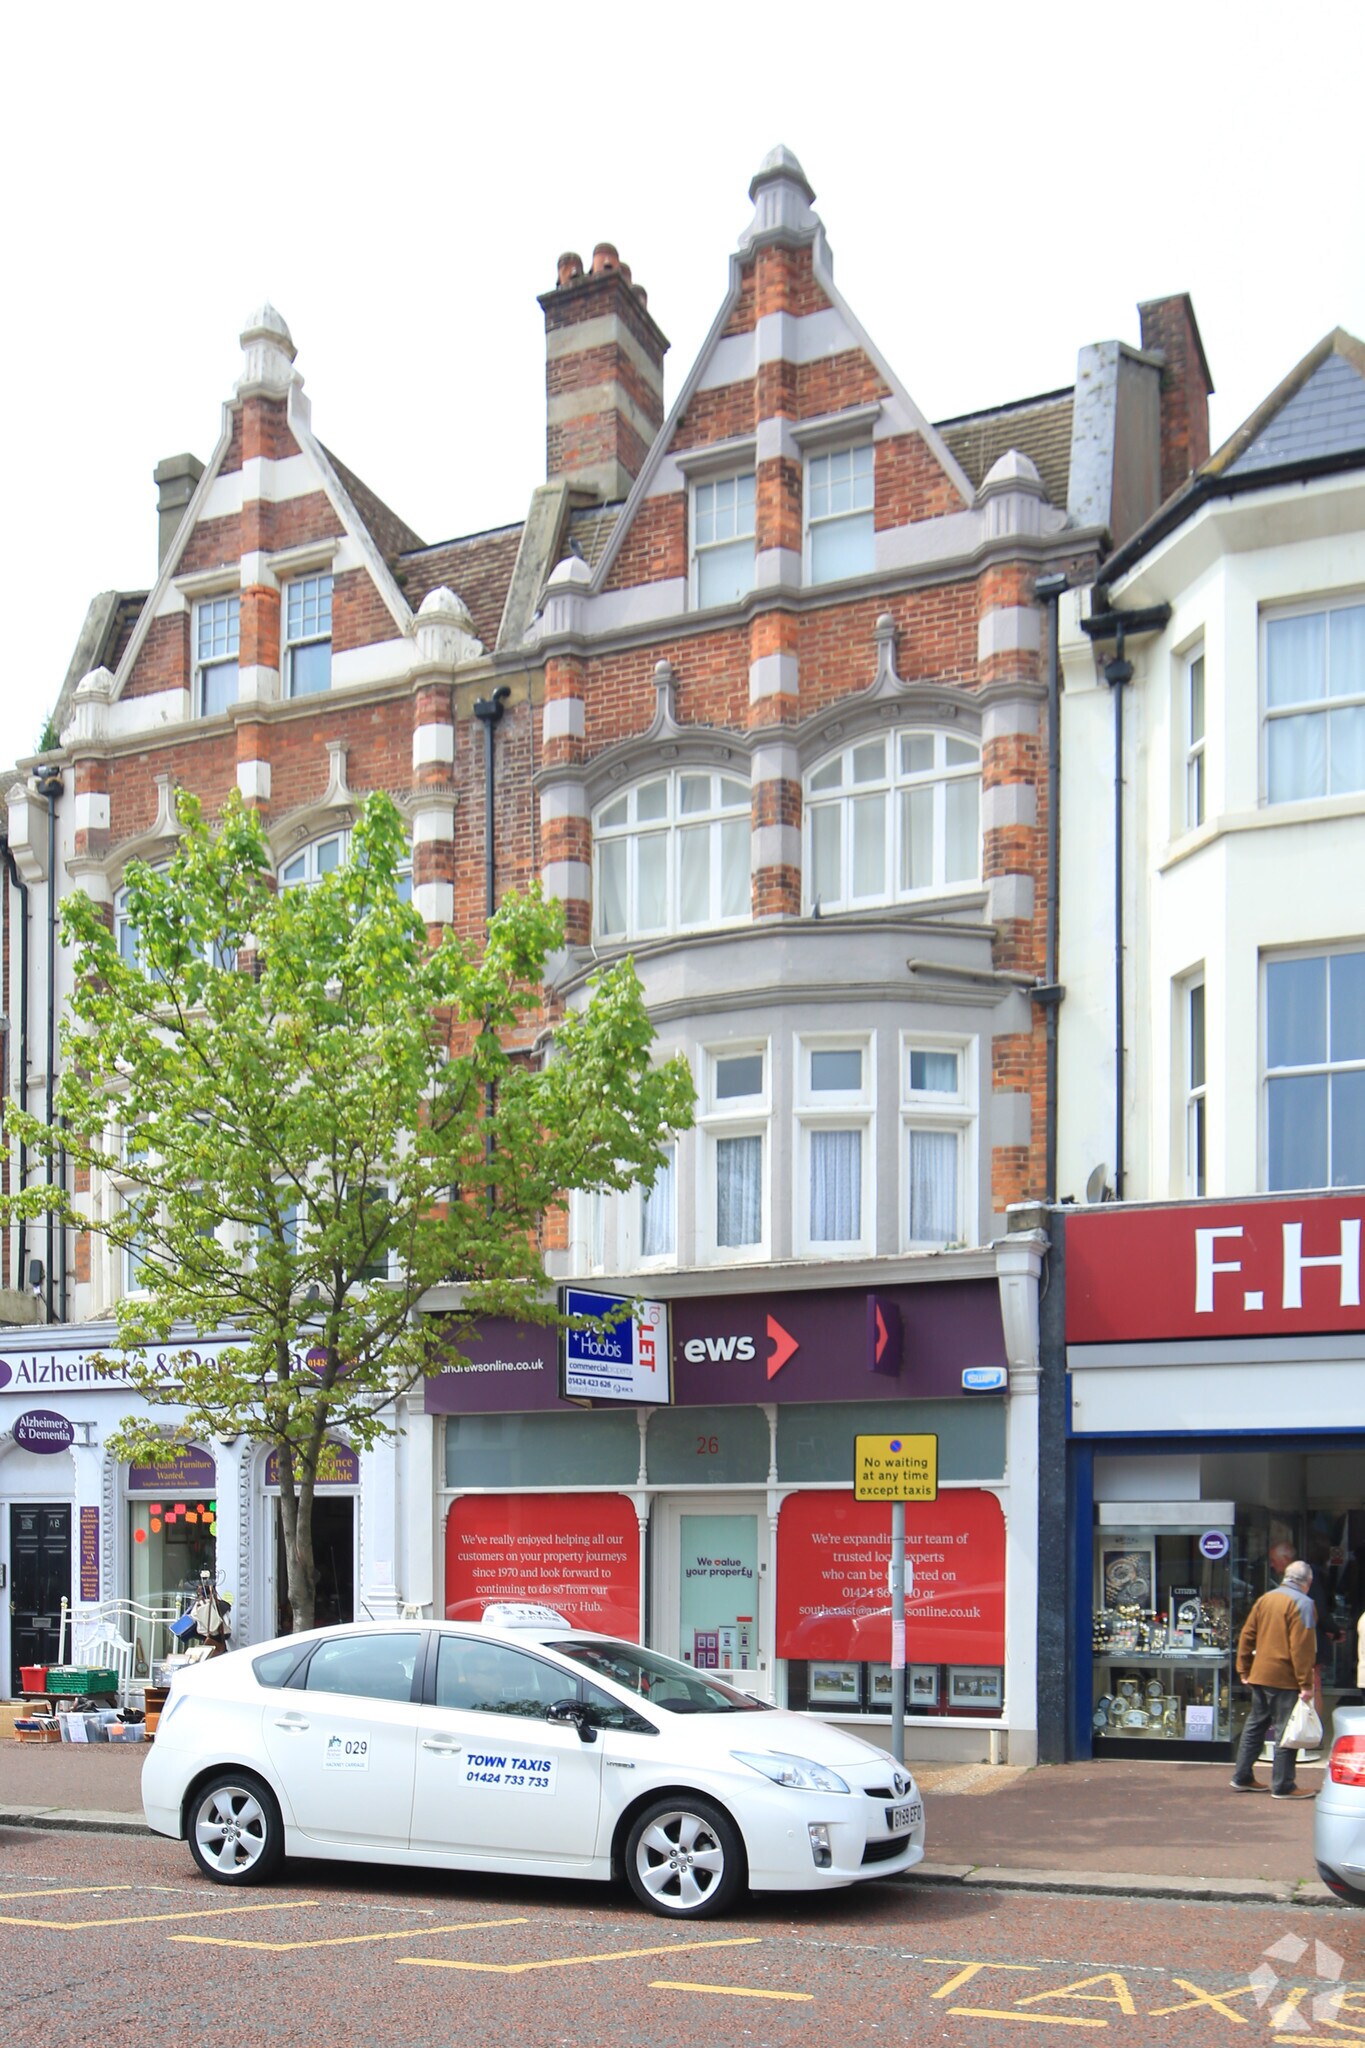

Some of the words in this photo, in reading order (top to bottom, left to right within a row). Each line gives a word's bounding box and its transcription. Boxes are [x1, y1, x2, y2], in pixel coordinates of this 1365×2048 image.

[649, 1305, 661, 1325] to
[639, 1324, 655, 1373] LET
[154, 1353, 172, 1377] &
[568, 1377, 586, 1386] 01424
[587, 1379, 599, 1387] 423
[600, 1380, 612, 1389] 626
[19, 1415, 69, 1430] Alzheimer's
[18, 1428, 26, 1439] &
[28, 1428, 70, 1441] Dementia
[696, 1435, 719, 1454] 26
[153, 1460, 177, 1471] Quality
[180, 1460, 212, 1469] Furniture
[864, 1458, 881, 1467] No
[885, 1457, 928, 1469] waiting
[157, 1471, 185, 1480] Wanted.
[862, 1471, 875, 1480] at
[878, 1472, 899, 1482] any
[903, 1471, 929, 1480] time
[860, 1486, 899, 1497] except
[903, 1485, 932, 1495] taxis
[461, 1534, 488, 1545] We've
[489, 1534, 515, 1546] really
[517, 1534, 552, 1547] enjoyed
[555, 1534, 590, 1547] helping
[592, 1534, 605, 1545] all
[606, 1536, 624, 1545] our
[812, 1533, 841, 1544] We're
[843, 1533, 897, 1546] expandin
[903, 1535, 922, 1545] our
[925, 1535, 954, 1545] team
[956, 1533, 969, 1544] of
[458, 1553, 504, 1561] customers
[506, 1553, 518, 1561] on
[520, 1553, 541, 1562] your
[543, 1552, 583, 1563] property
[586, 1551, 627, 1563] journeys
[697, 1557, 712, 1566] We
[833, 1551, 872, 1562] trusted
[875, 1551, 893, 1562] loc
[903, 1552, 945, 1564] experts
[472, 1567, 496, 1577] since
[498, 1567, 519, 1577] 1970
[520, 1567, 538, 1577] and
[540, 1567, 560, 1577] look
[562, 1567, 599, 1577] forward
[601, 1568, 611, 1577] to
[686, 1568, 707, 1578] your
[822, 1569, 845, 1580] who
[847, 1571, 867, 1580] can
[869, 1569, 882, 1580] be
[885, 1569, 939, 1580] acted
[942, 1572, 956, 1581] on
[475, 1584, 526, 1596] continuing
[527, 1585, 537, 1595] to
[538, 1584, 551, 1595] do
[553, 1586, 565, 1595] so
[565, 1584, 589, 1595] from
[590, 1586, 608, 1595] our
[842, 1587, 874, 1598] 01424
[923, 1589, 935, 1599] or
[579, 1601, 602, 1612] Hub.
[799, 1604, 981, 1617] southcoast@andrsonline.co.uk
[345, 1741, 368, 1755] 029
[466, 1754, 507, 1769] TOWN
[510, 1759, 551, 1773] TAXIS
[466, 1771, 501, 1784] 01424
[504, 1774, 525, 1786] 733
[528, 1776, 549, 1788] 733
